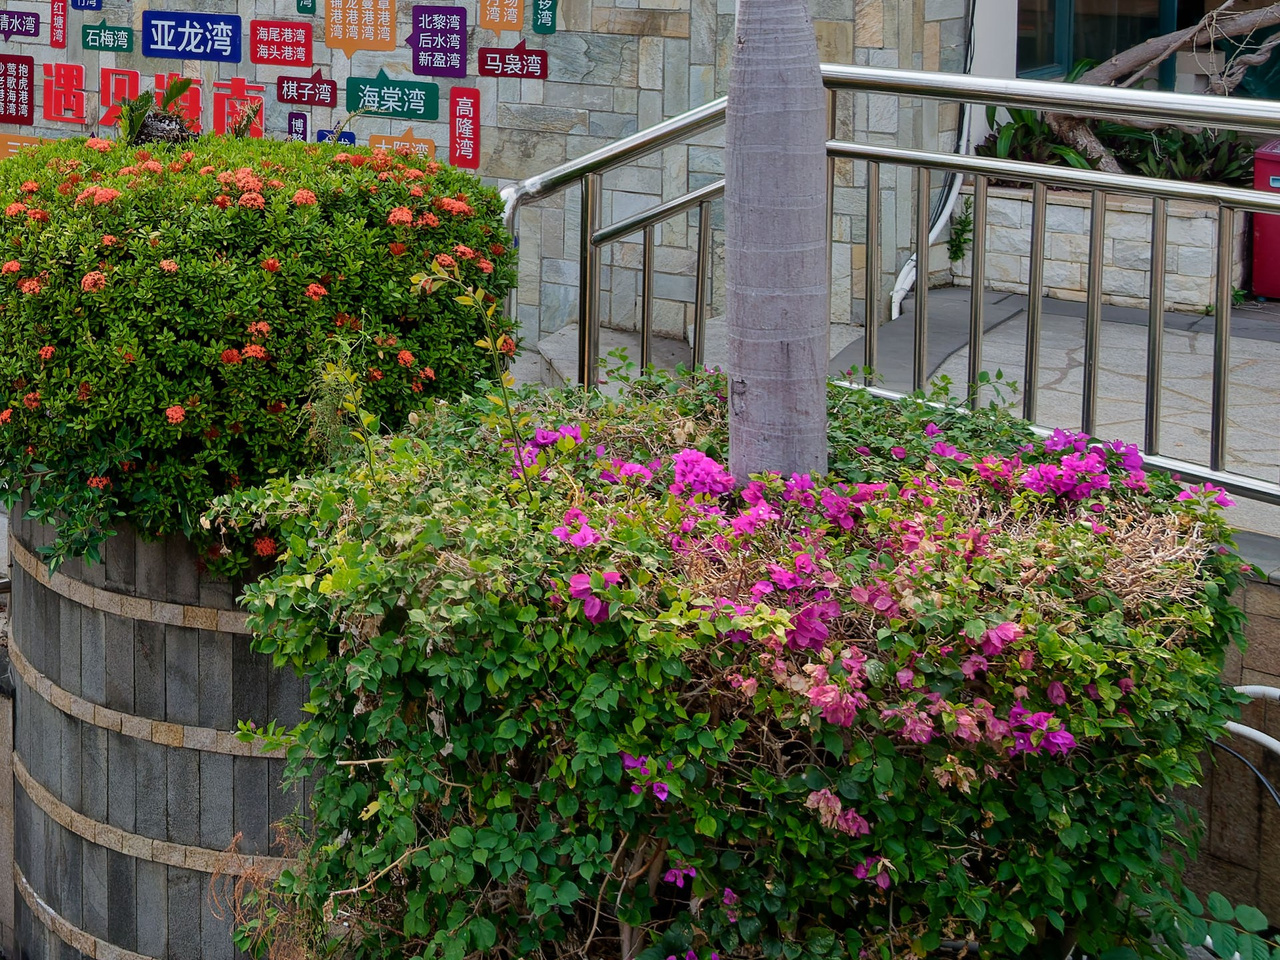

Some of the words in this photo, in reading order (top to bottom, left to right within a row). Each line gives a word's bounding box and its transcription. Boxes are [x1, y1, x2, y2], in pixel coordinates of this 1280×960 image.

[53, 1, 64, 43] 红塘湾
[418, 14, 461, 30] 北黎湾
[86, 29, 128, 49] 石梅湾
[150, 19, 233, 56] 亚龙湾
[256, 26, 306, 44] 海尾港湾
[418, 33, 461, 50] 后水湾
[256, 44, 306, 61] 海头港湾
[418, 51, 461, 69] 新盈湾
[485, 53, 542, 76] 马袅湾
[6, 63, 17, 116] 莺歌海湾
[18, 64, 29, 117] 抱虎港湾
[282, 80, 332, 103] 棋子湾
[358, 84, 426, 114] 海棠湾
[456, 97, 474, 159] 高隆湾
